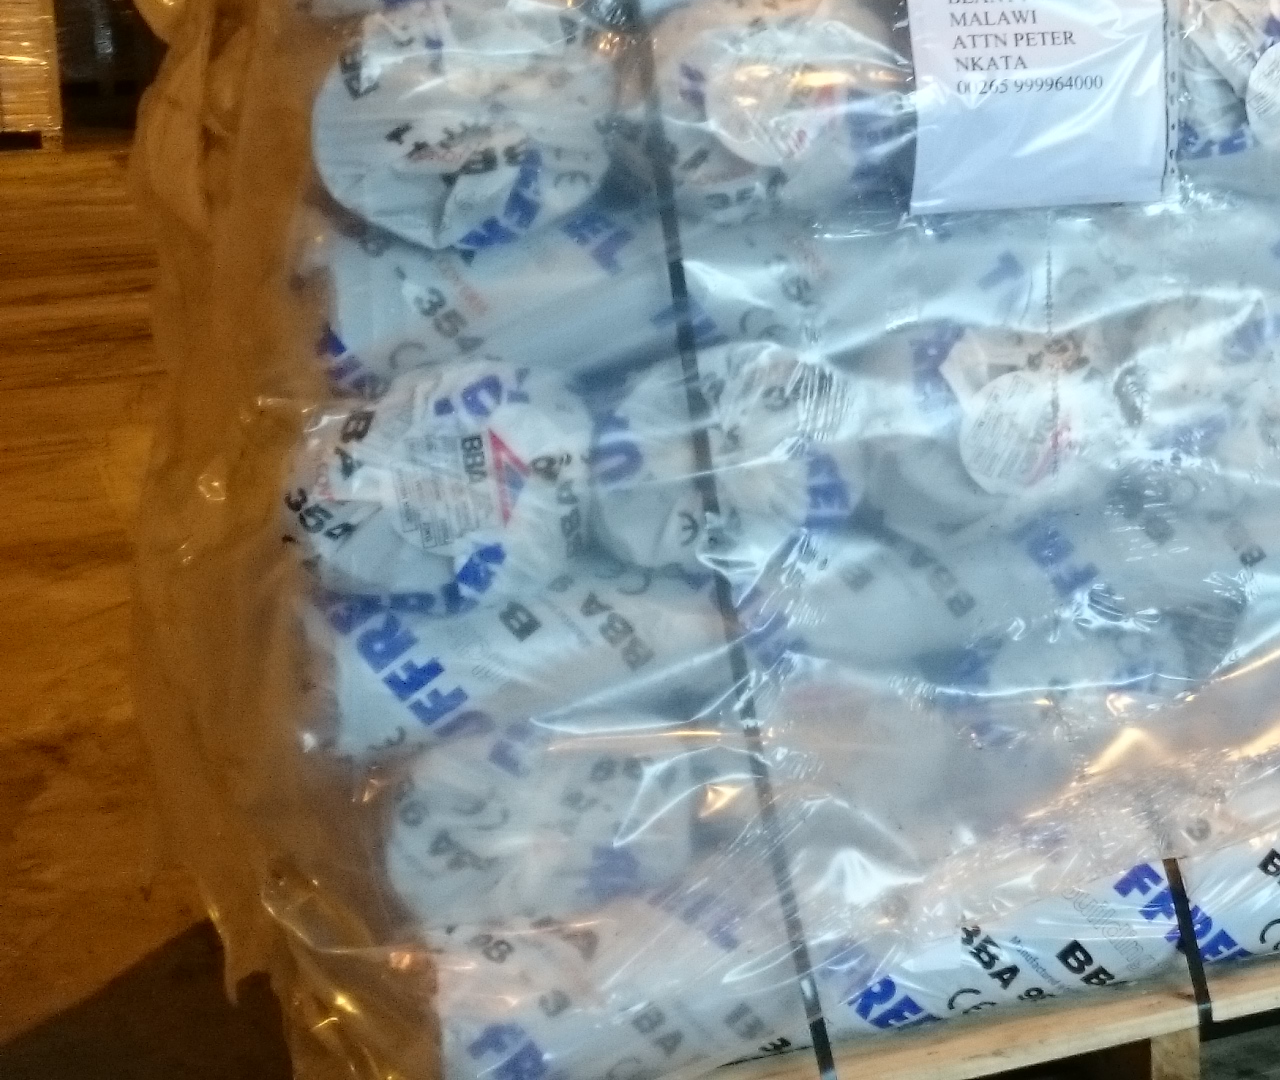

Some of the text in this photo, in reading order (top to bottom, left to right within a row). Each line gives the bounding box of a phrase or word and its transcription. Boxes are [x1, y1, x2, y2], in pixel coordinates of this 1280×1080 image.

[949, 10, 1037, 28] MALAWI
[951, 31, 1076, 50] ATTN PETER
[954, 56, 1028, 71] NKATA
[956, 75, 1103, 95] 00265 999964000
